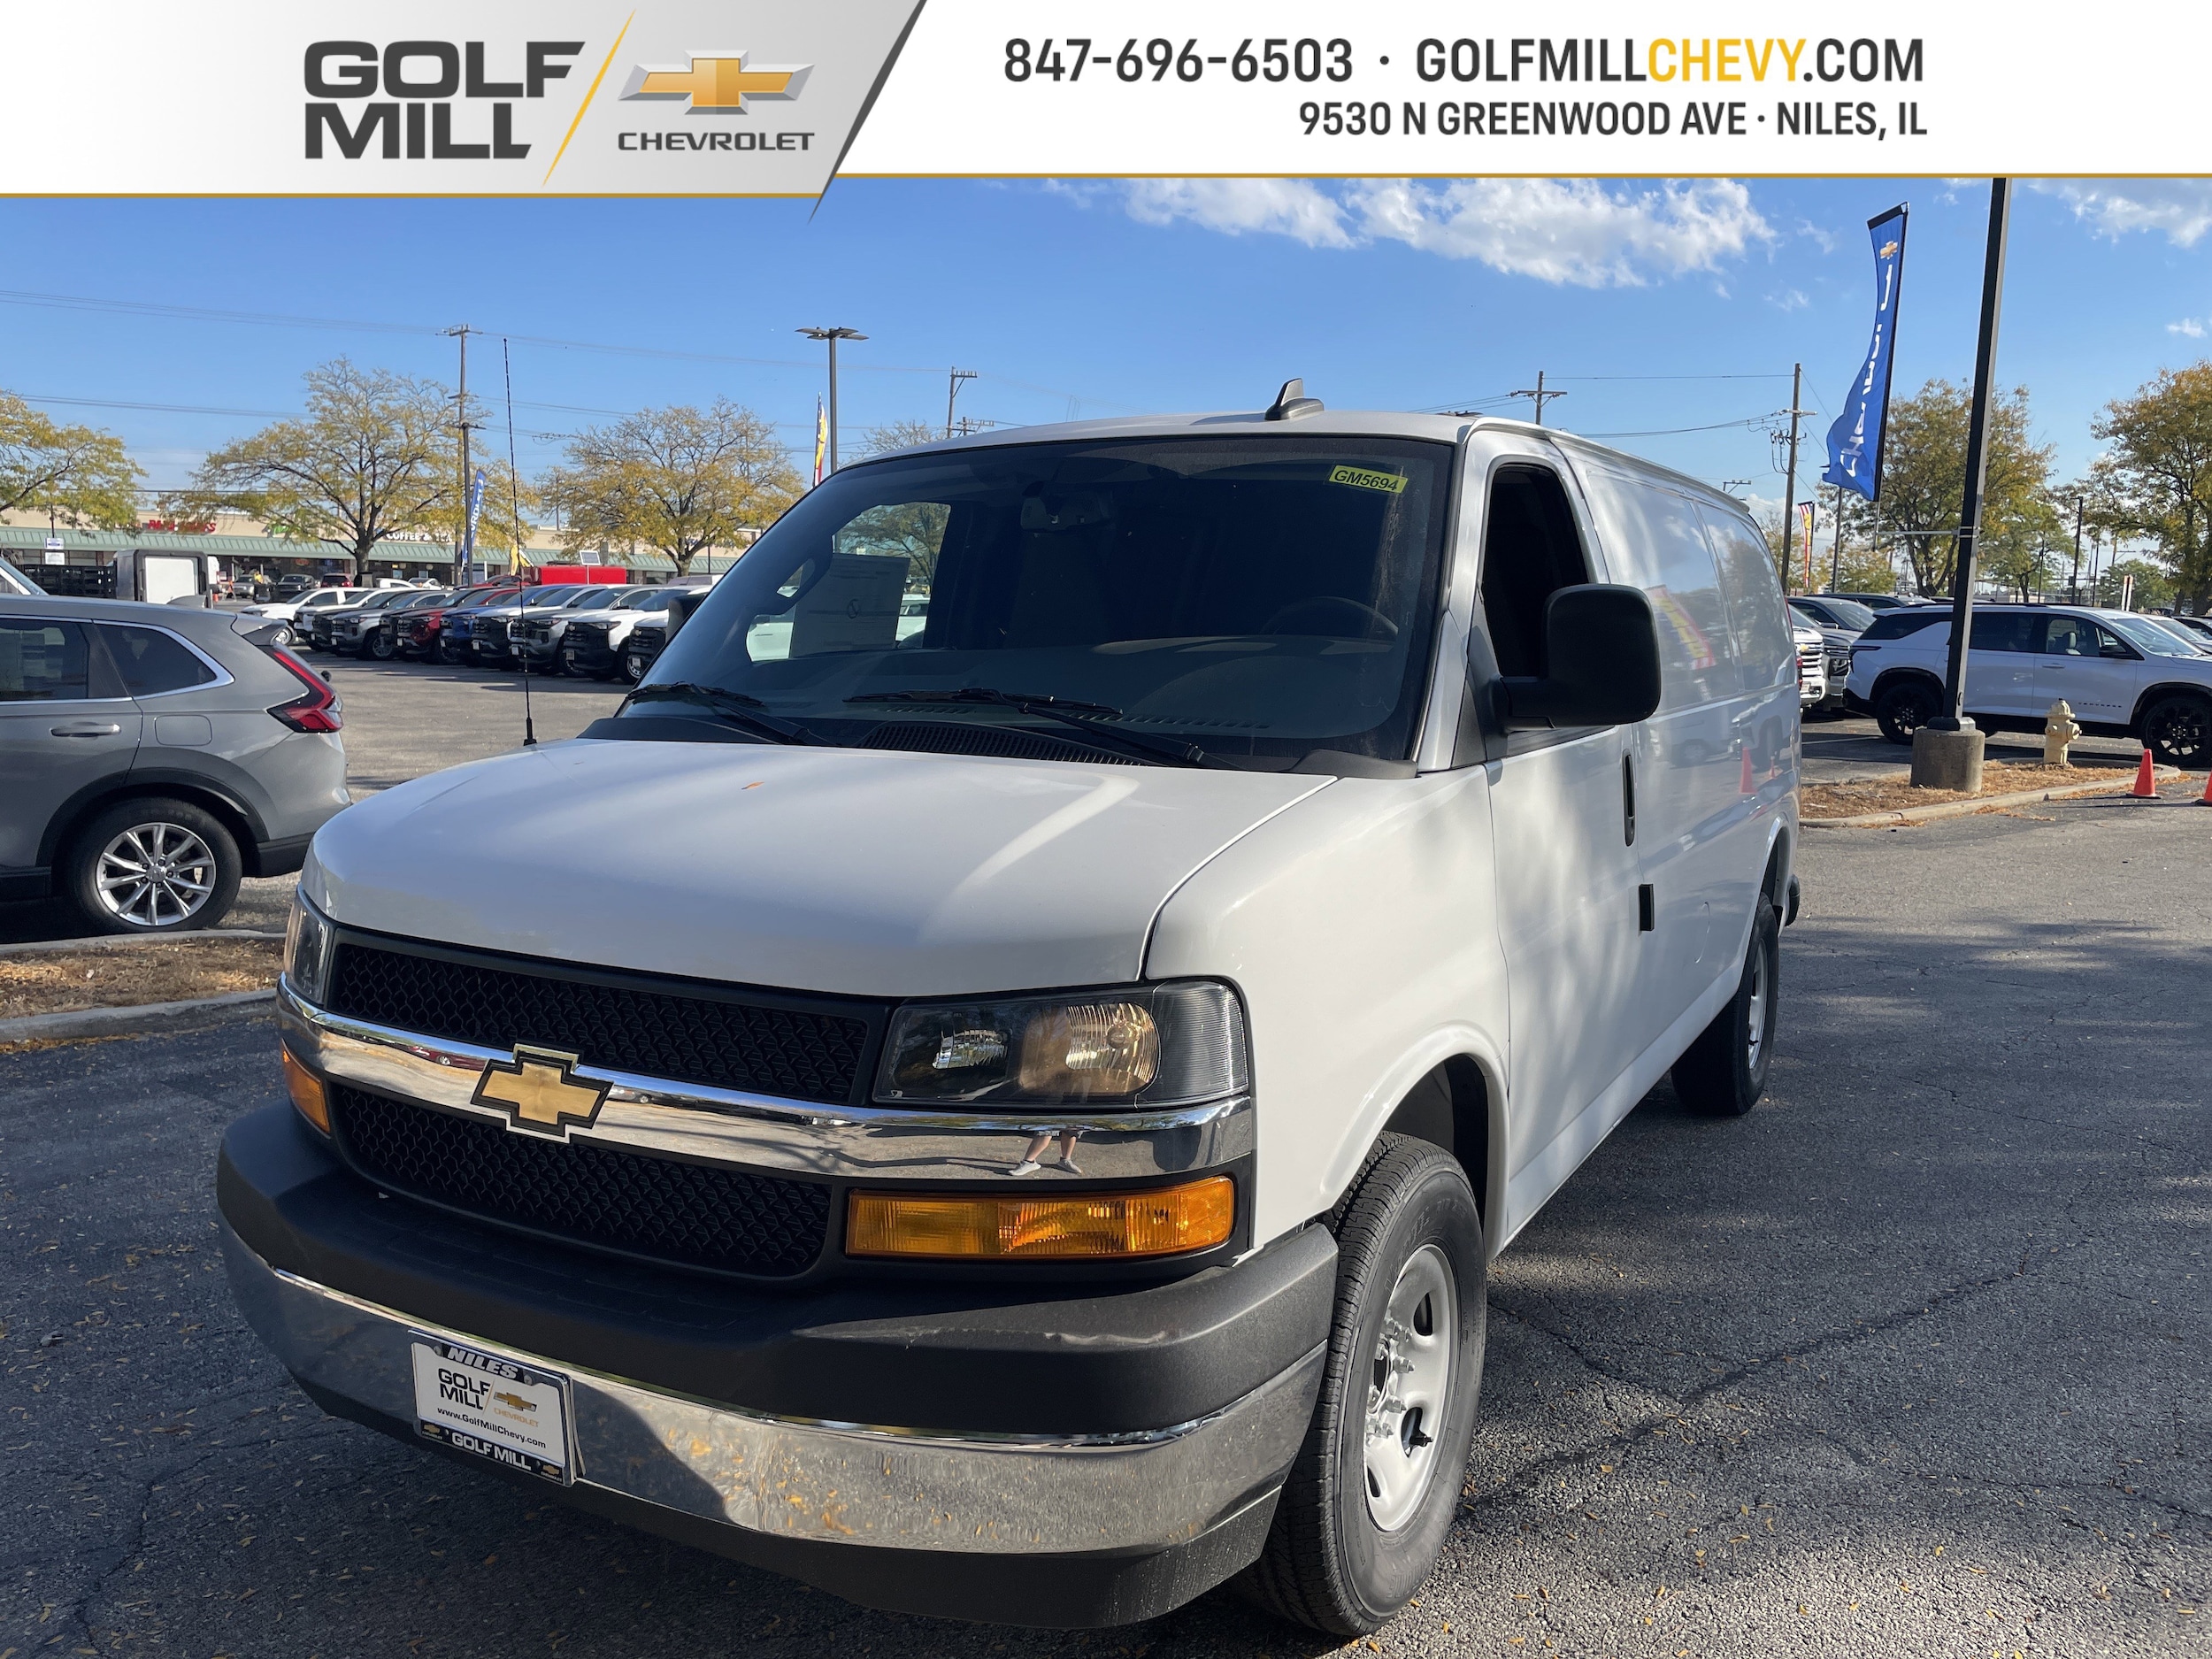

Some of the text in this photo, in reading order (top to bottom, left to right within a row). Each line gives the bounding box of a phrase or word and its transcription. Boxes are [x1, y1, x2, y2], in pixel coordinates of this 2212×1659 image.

[1334, 470, 1399, 491] GM5694
[448, 1348, 518, 1379] NILES
[438, 1369, 491, 1396] GOLF
[440, 1383, 484, 1410] MILL
[437, 1407, 547, 1449] www.GolfMillChevy.com
[494, 1407, 540, 1428] CHEVROLET
[452, 1432, 532, 1471] GOLF MILL
